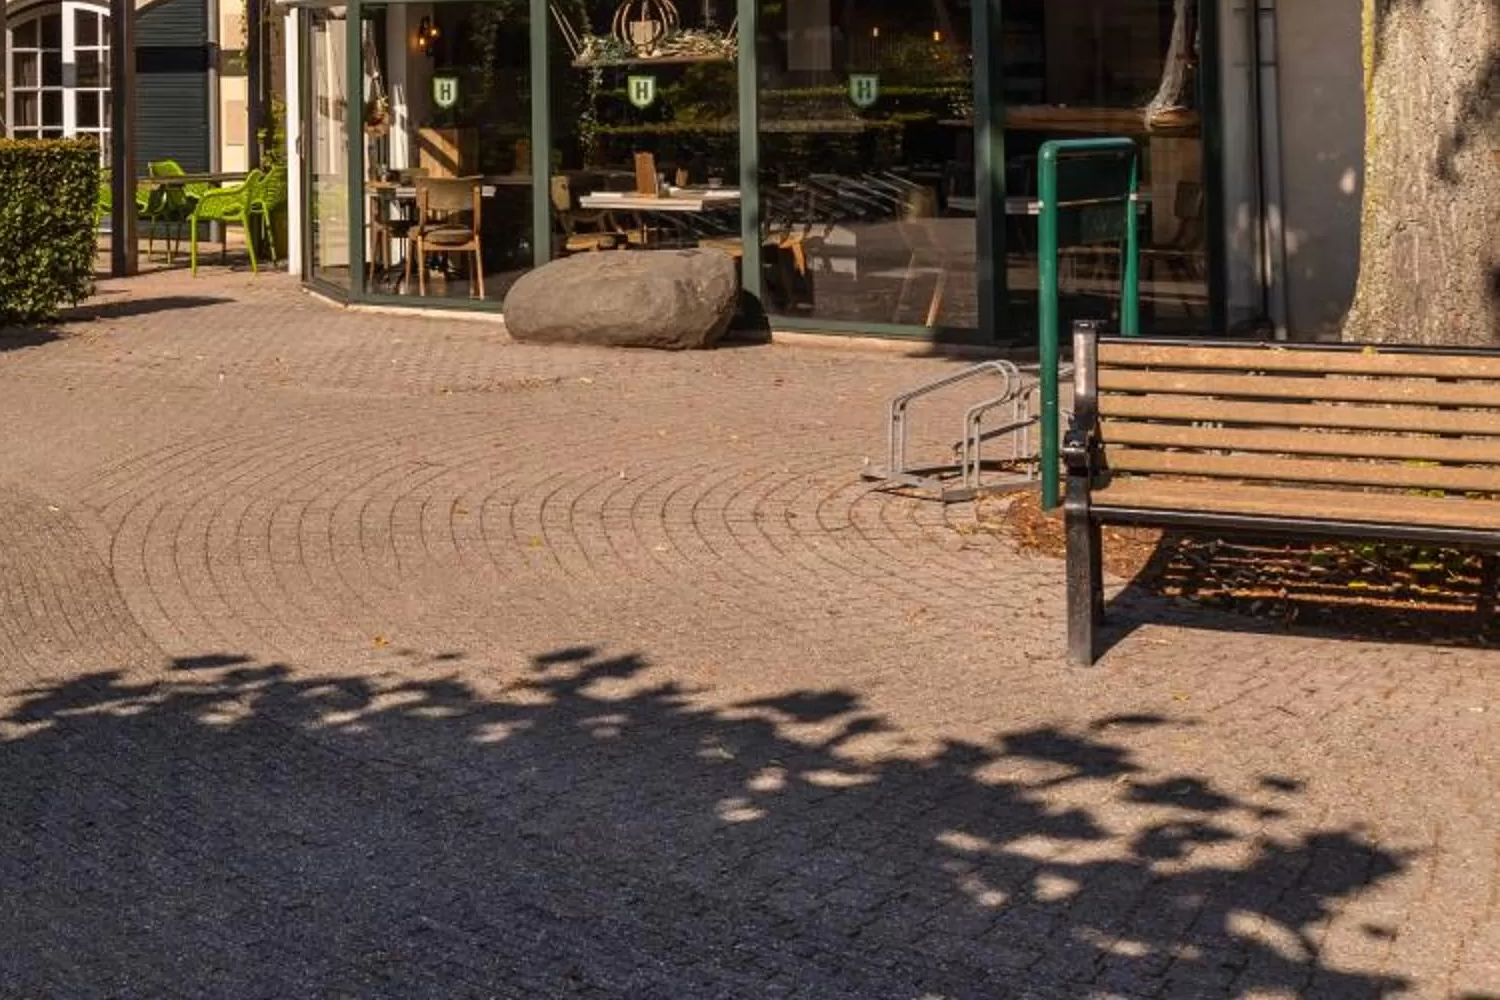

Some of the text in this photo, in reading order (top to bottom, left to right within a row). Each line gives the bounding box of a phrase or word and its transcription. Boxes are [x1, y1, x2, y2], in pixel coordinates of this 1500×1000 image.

[439, 82, 451, 101] H
[635, 81, 649, 100] H
[857, 79, 871, 100] H
